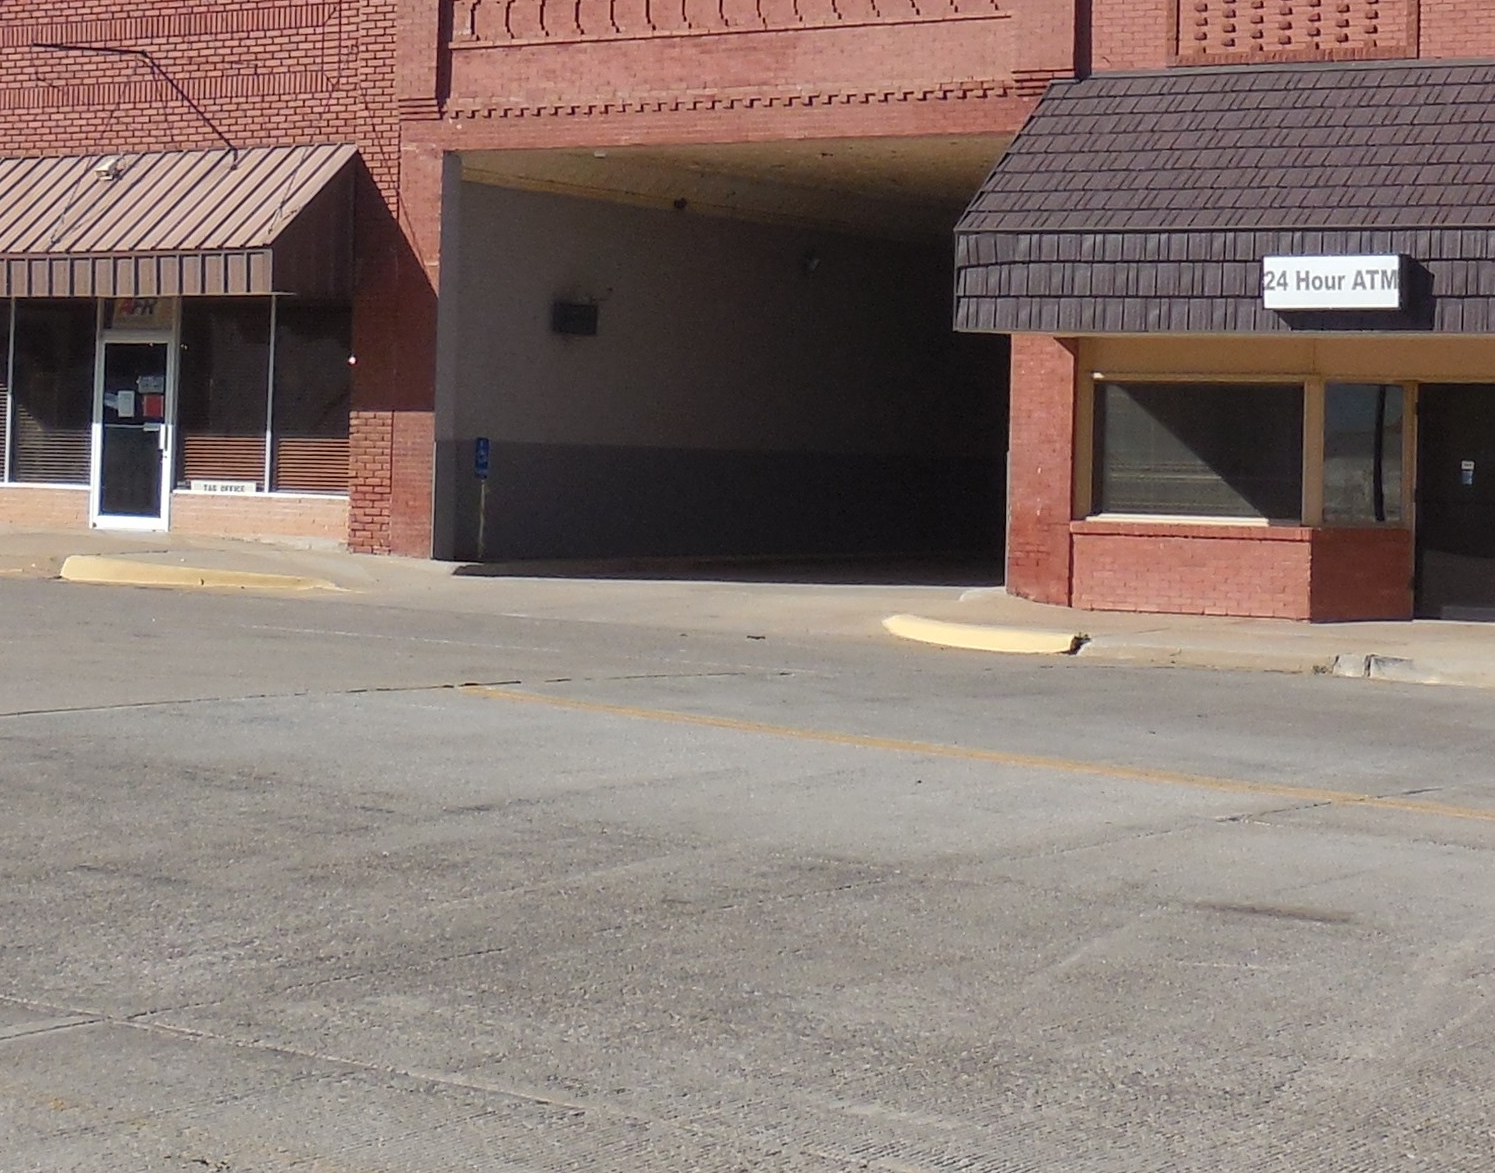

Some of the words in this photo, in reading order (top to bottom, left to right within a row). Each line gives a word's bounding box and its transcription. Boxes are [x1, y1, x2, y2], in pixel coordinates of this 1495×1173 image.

[1264, 270, 1288, 291] 24
[1295, 270, 1346, 291] Hour
[1351, 269, 1399, 290] ATM
